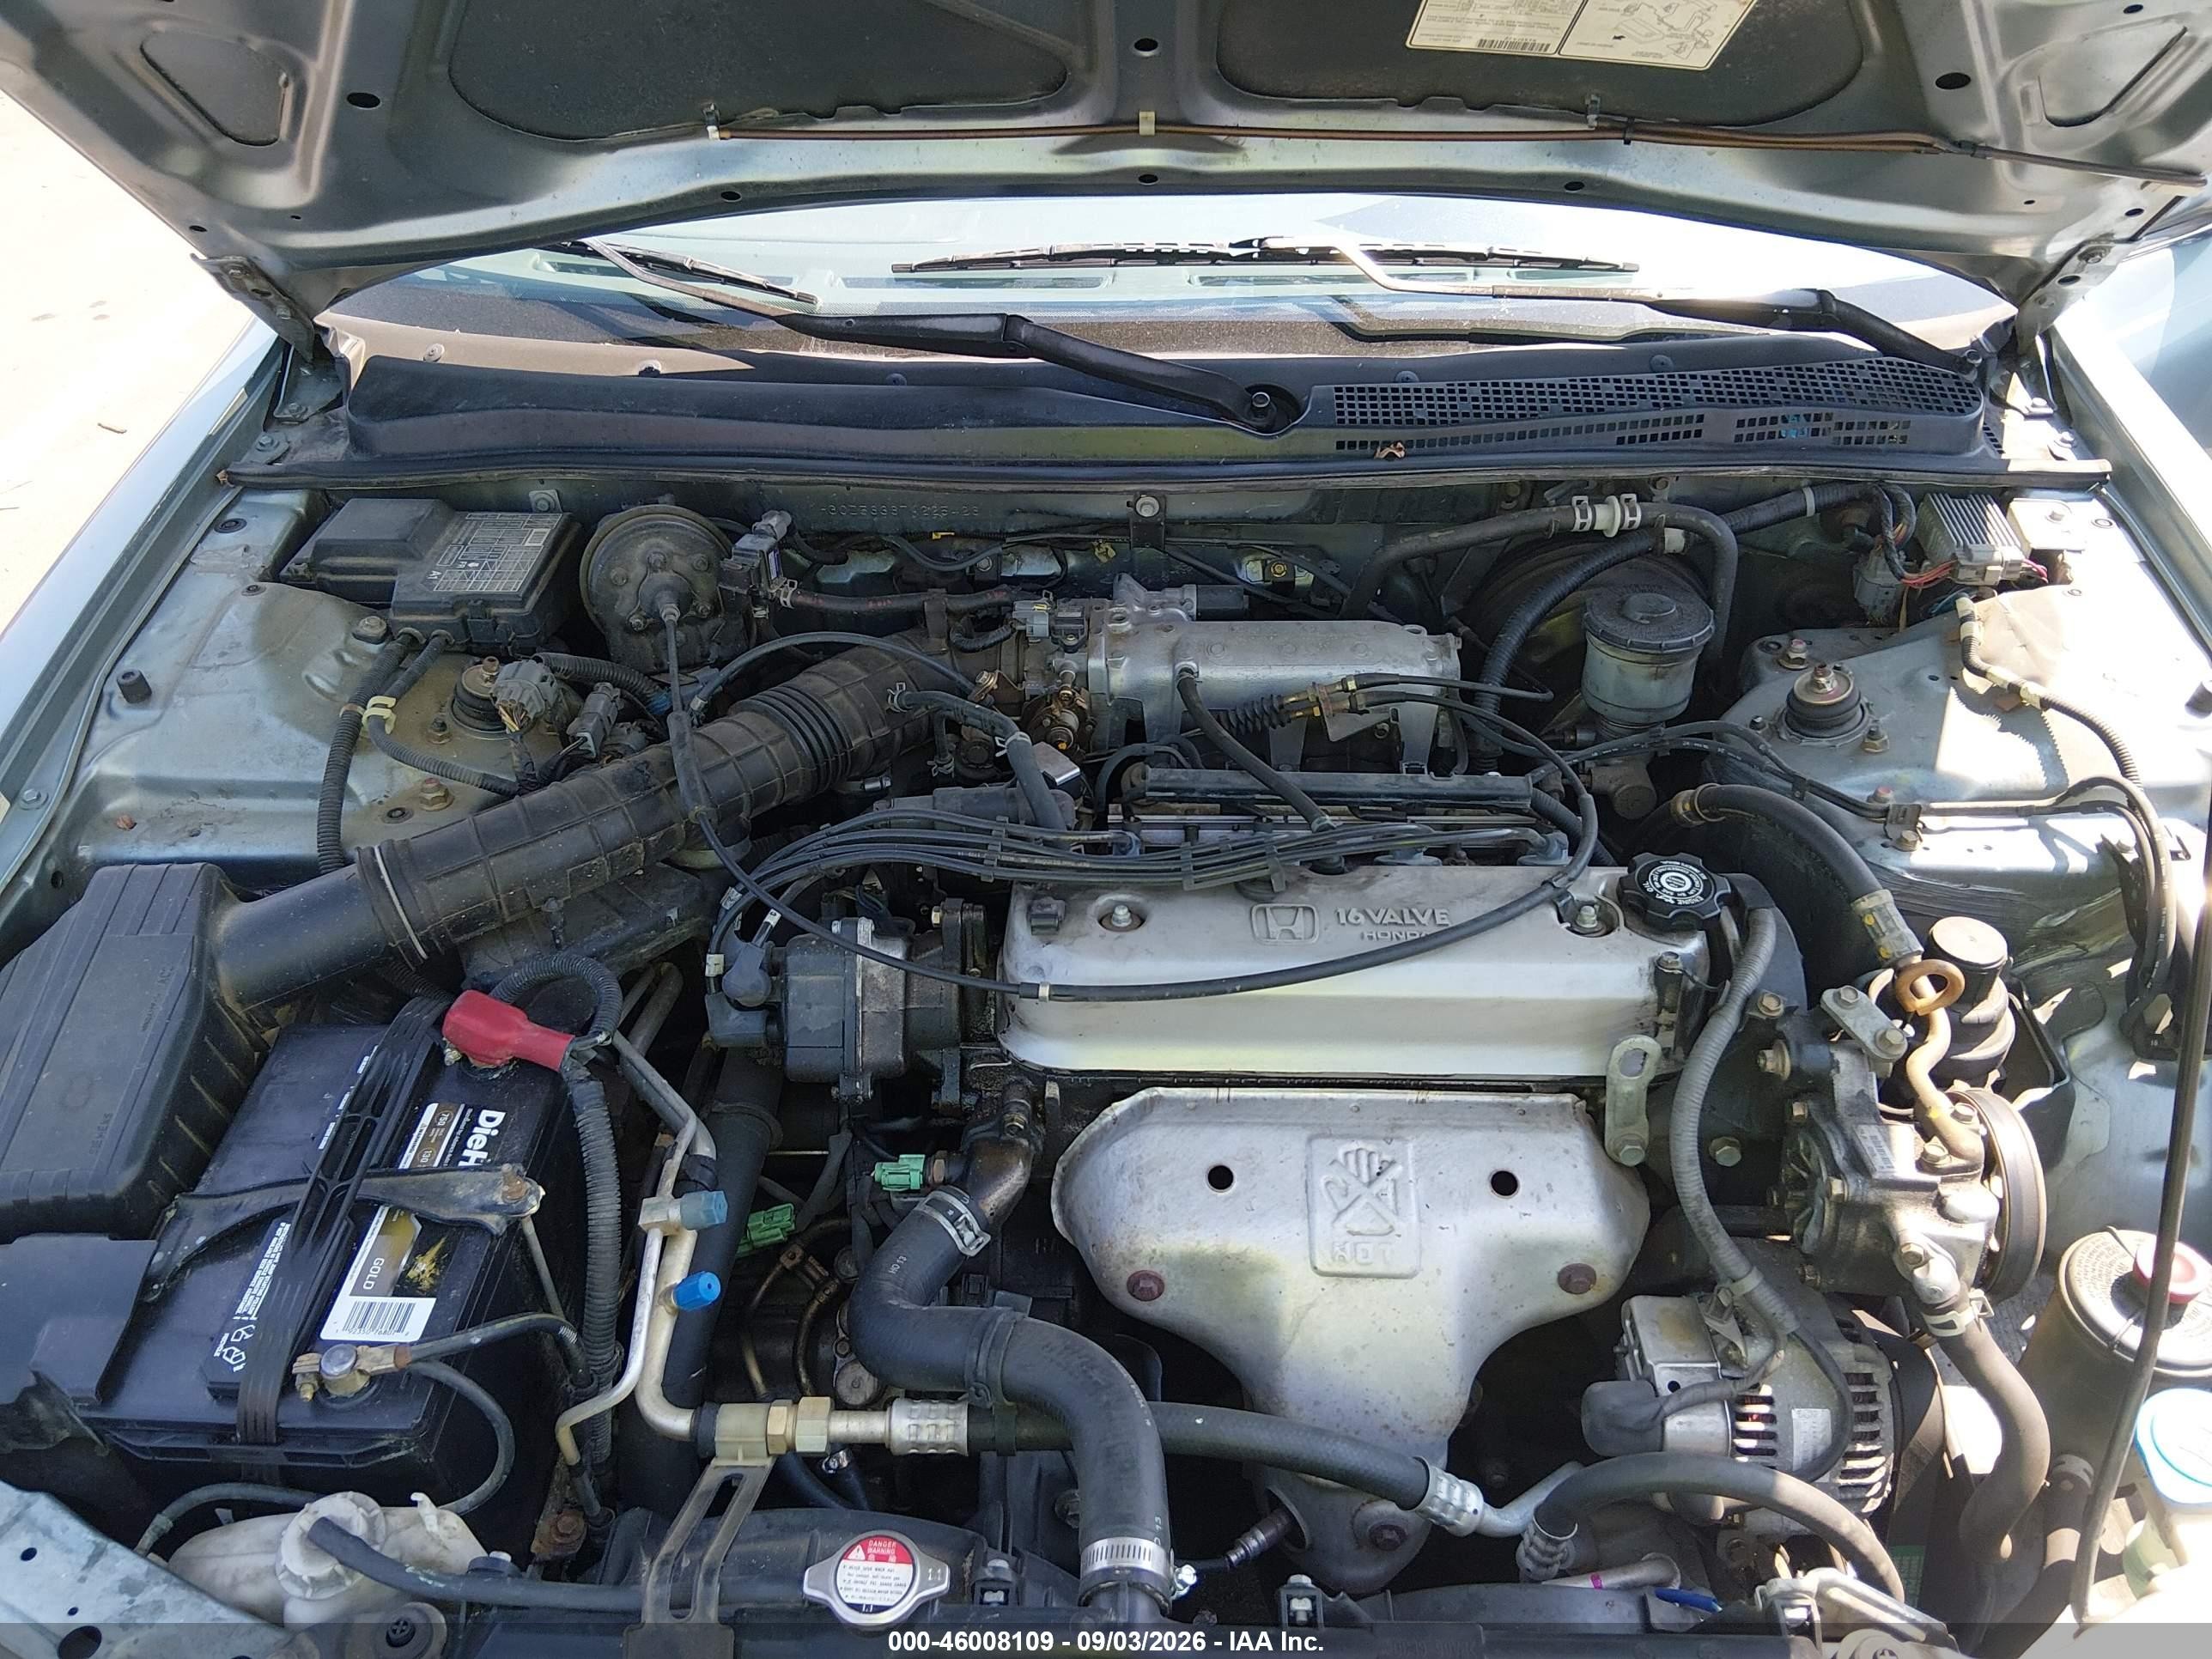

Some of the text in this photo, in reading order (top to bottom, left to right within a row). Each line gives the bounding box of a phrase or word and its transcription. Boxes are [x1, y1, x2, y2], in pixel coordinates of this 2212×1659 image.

[362, 1256, 384, 1291] GOLD
[868, 1539, 896, 1548] DANGER
[866, 1547, 896, 1555] WARNING
